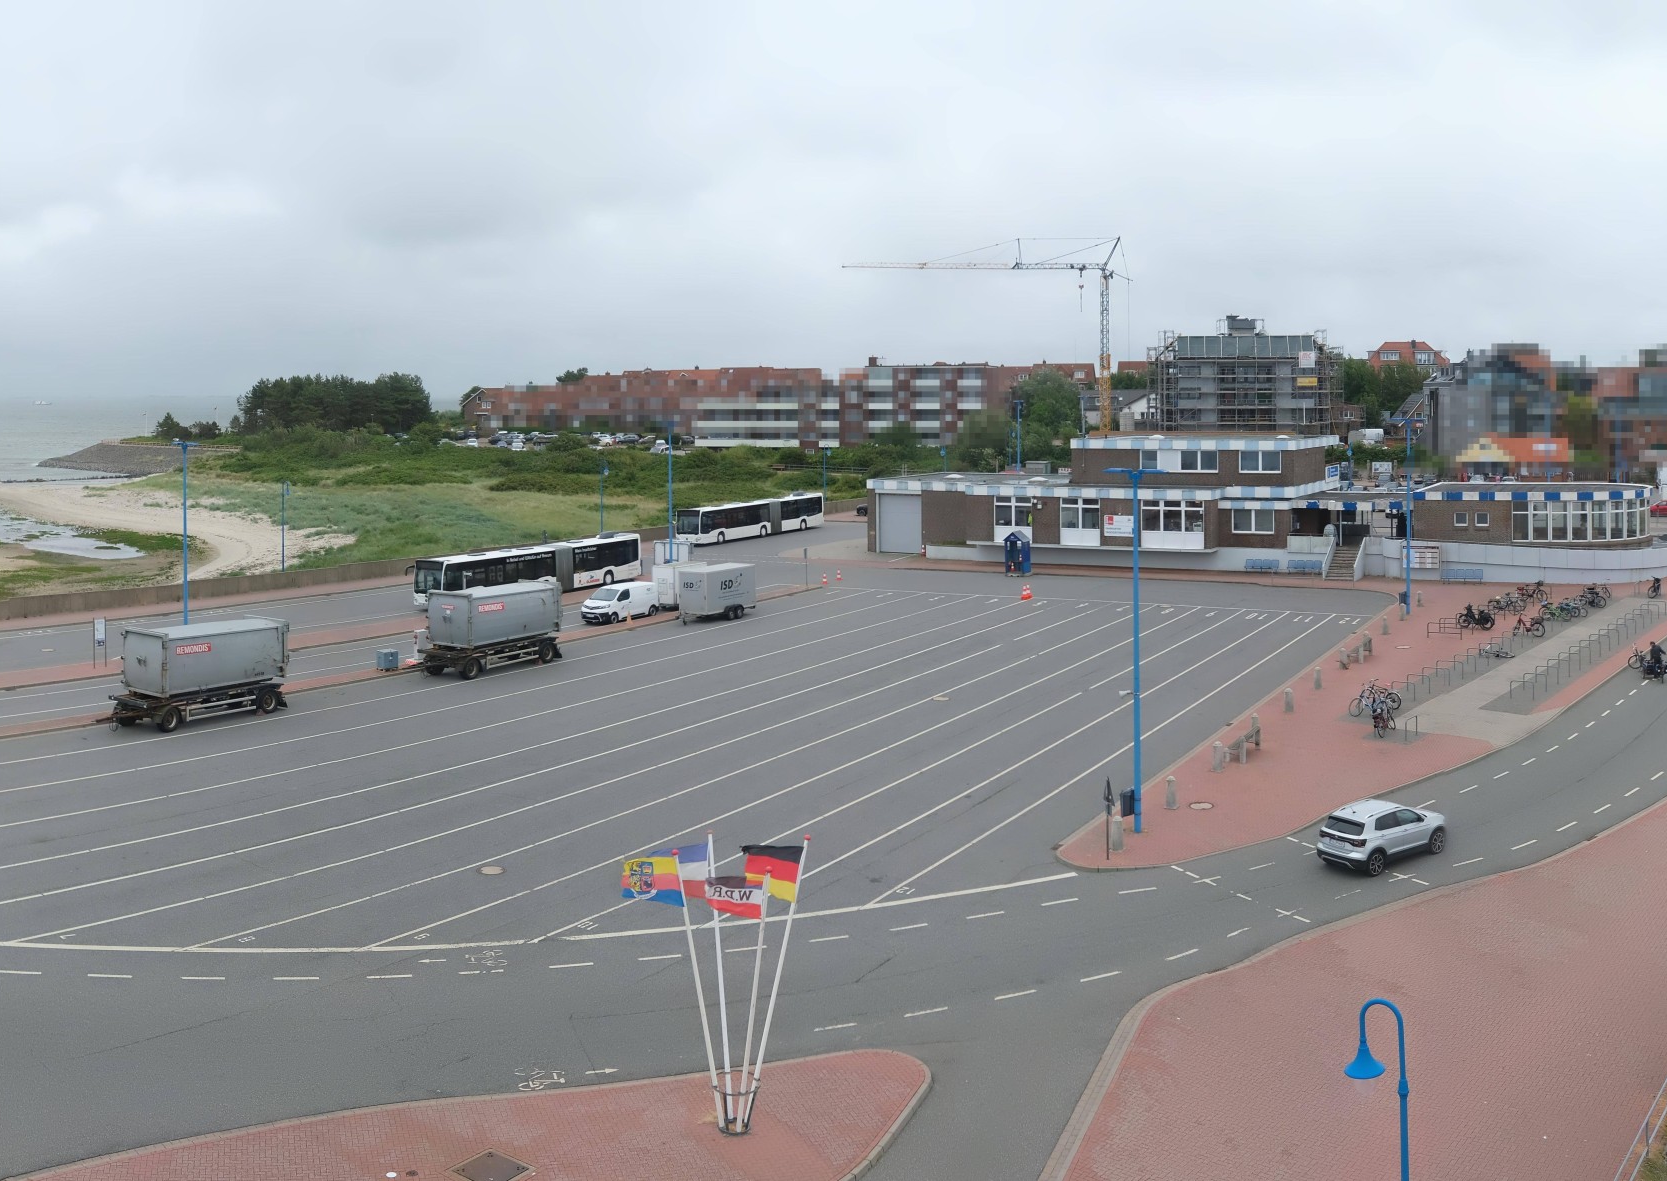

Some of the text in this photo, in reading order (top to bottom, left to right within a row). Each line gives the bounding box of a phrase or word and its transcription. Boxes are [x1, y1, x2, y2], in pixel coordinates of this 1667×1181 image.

[721, 579, 734, 590] ISD
[478, 602, 504, 612] REMONDIS
[176, 643, 210, 655] REMONDIS
